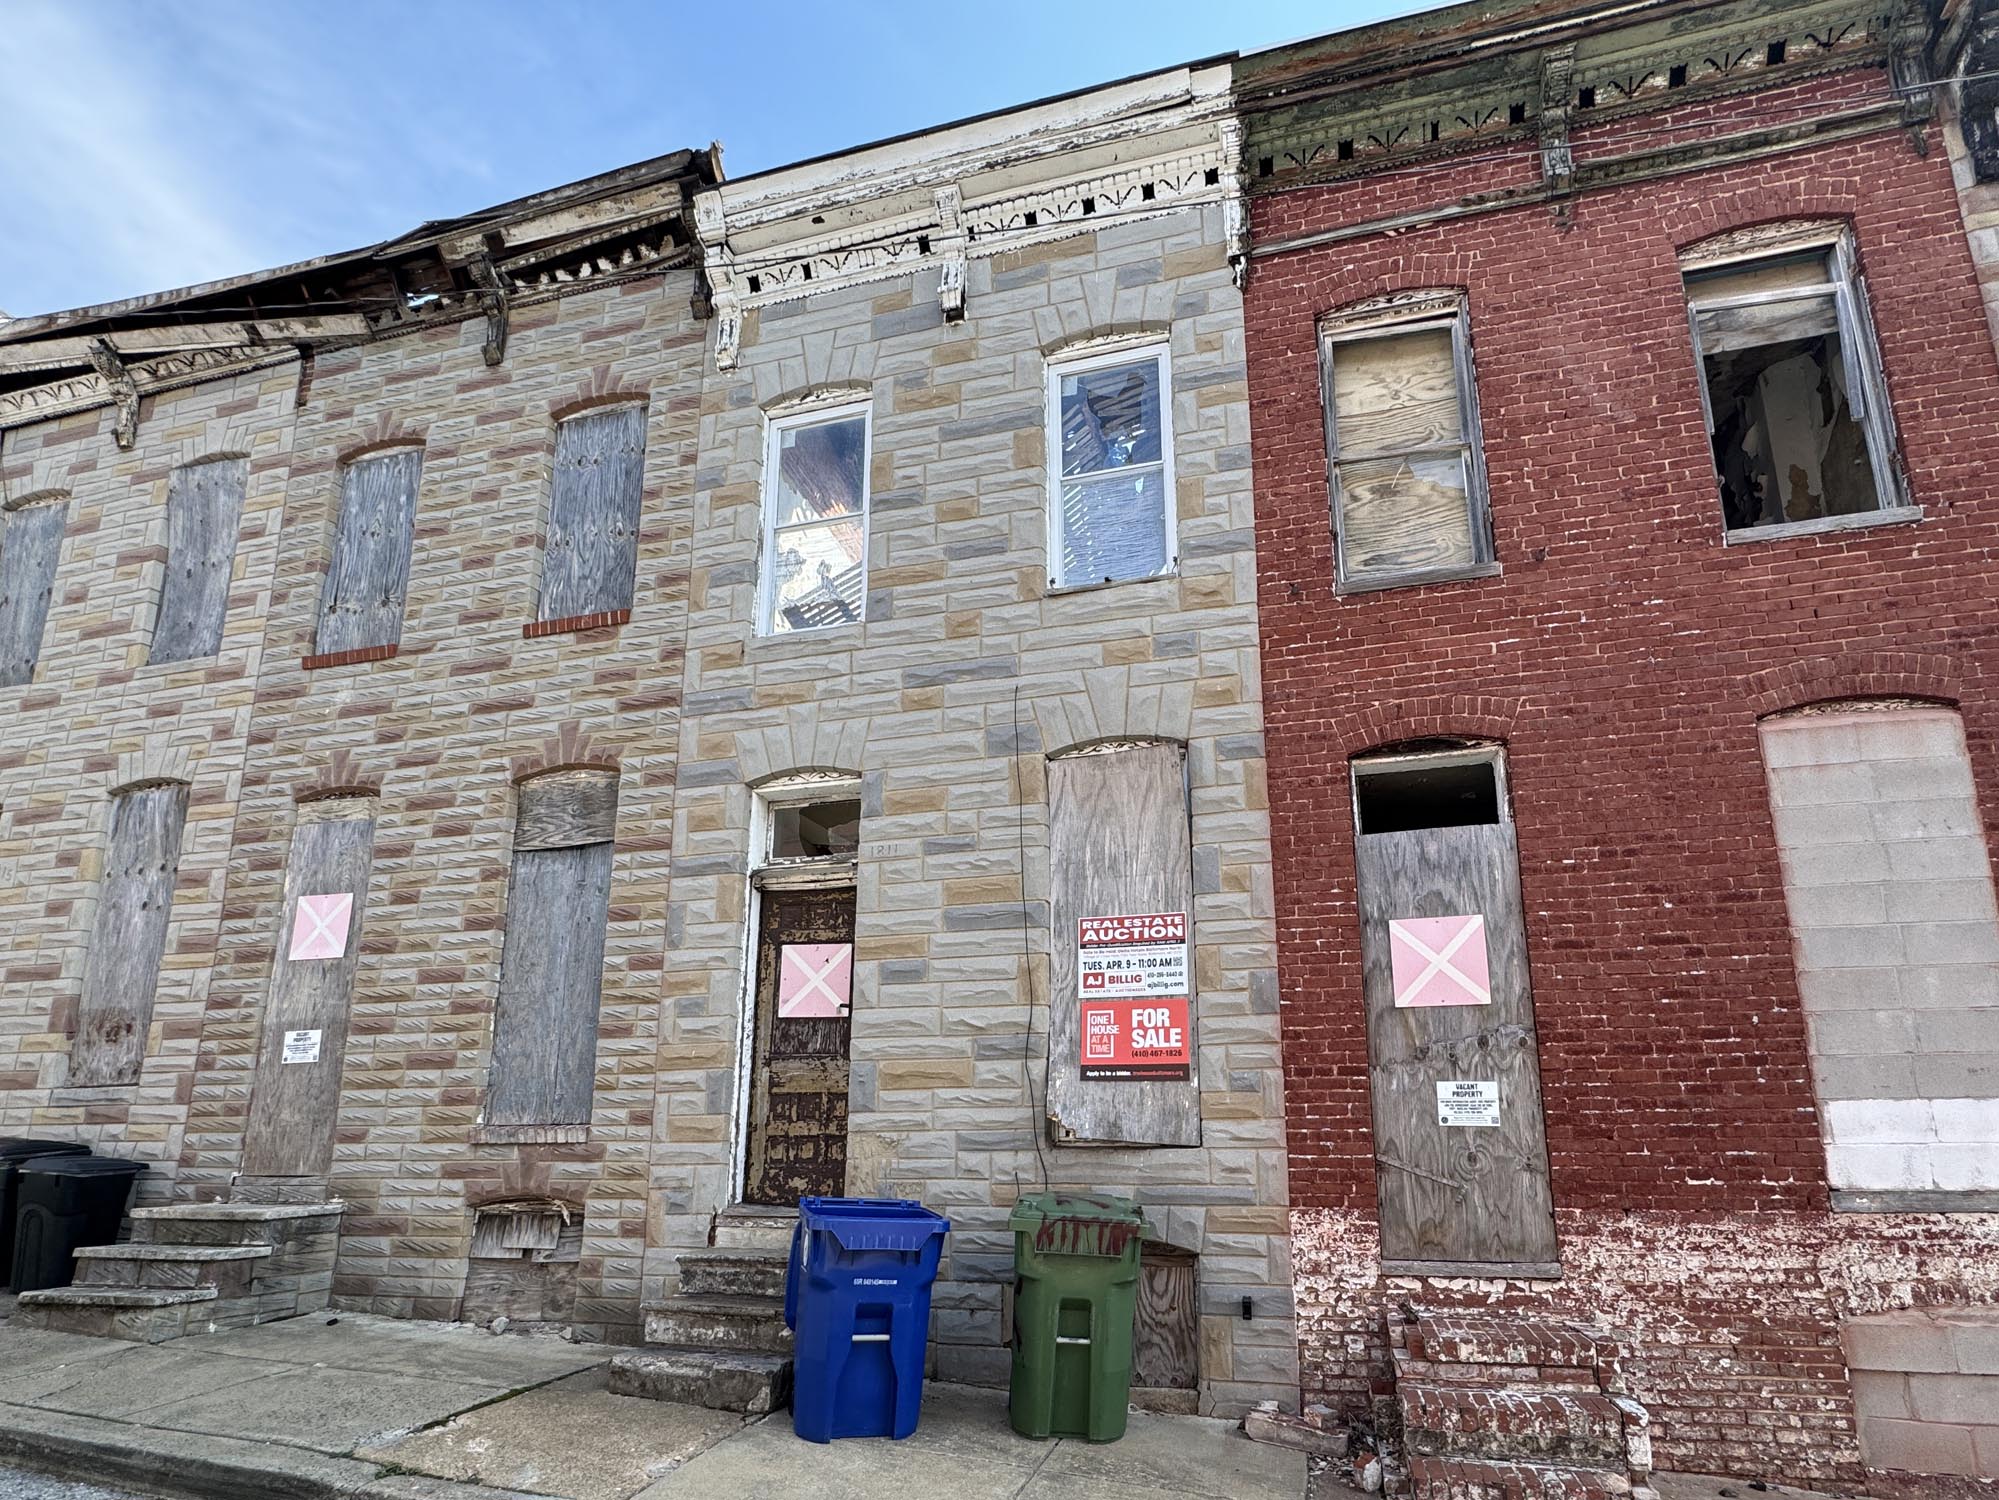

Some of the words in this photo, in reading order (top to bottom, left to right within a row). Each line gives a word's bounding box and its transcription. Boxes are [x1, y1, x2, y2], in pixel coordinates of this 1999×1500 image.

[1082, 920, 1121, 929] REAL
[1124, 916, 1183, 927] ESTATE
[1082, 925, 1183, 941] AUCTION
[1083, 961, 1105, 970] TUES.
[1106, 960, 1125, 970] APR.
[1126, 960, 1131, 969] 9
[1138, 958, 1157, 968] 11:00
[1158, 957, 1172, 967] AM
[1086, 976, 1102, 986] AJ
[1108, 975, 1143, 984] BILLIG
[1091, 1015, 1110, 1024] ONE
[1131, 1008, 1170, 1027] FOR
[1091, 1025, 1120, 1034] HOUSE
[1131, 1028, 1182, 1048] SALE
[1091, 1045, 1110, 1053] TIME
[1131, 1050, 1149, 1058] (410)
